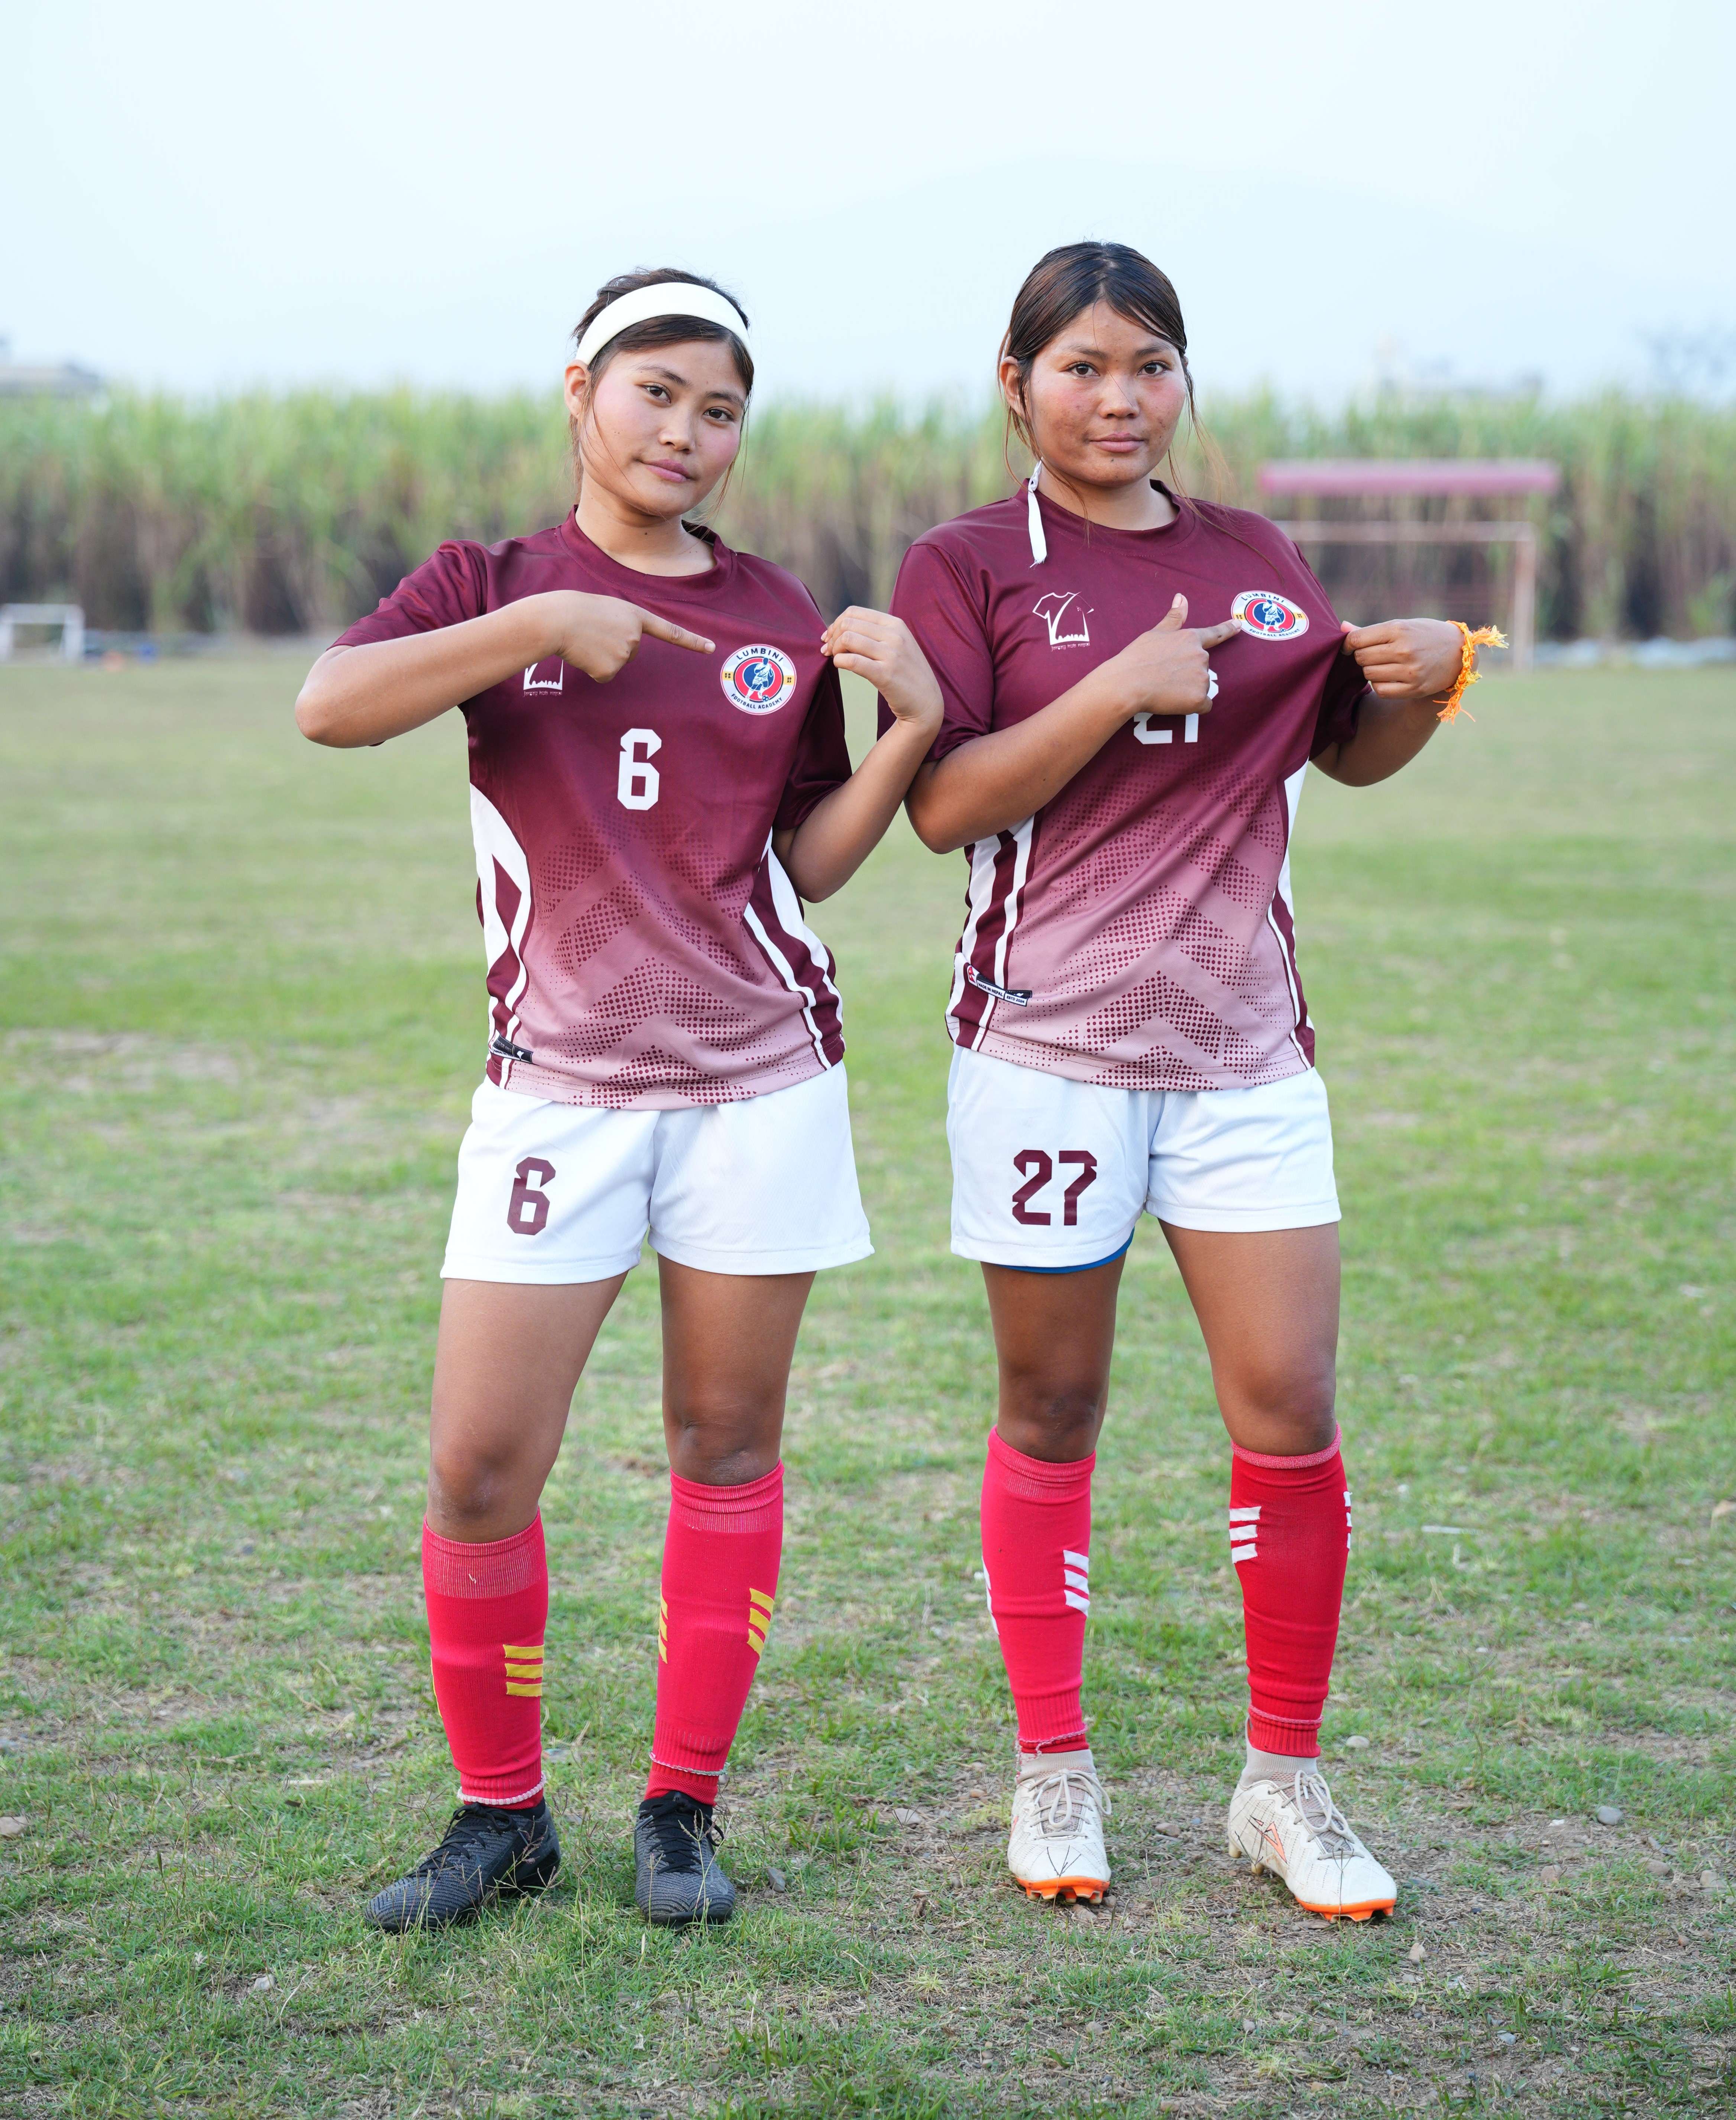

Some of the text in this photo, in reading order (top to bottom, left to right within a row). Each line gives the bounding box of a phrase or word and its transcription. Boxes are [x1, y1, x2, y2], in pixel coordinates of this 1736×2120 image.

[1241, 593, 1284, 603] LUMBINI
[736, 648, 783, 662] LUMBINI
[731, 693, 782, 709] FOOTBALL ACADEMY
[617, 728, 662, 810] 6
[507, 1157, 556, 1235] 6
[1012, 1149, 1097, 1225] 27
